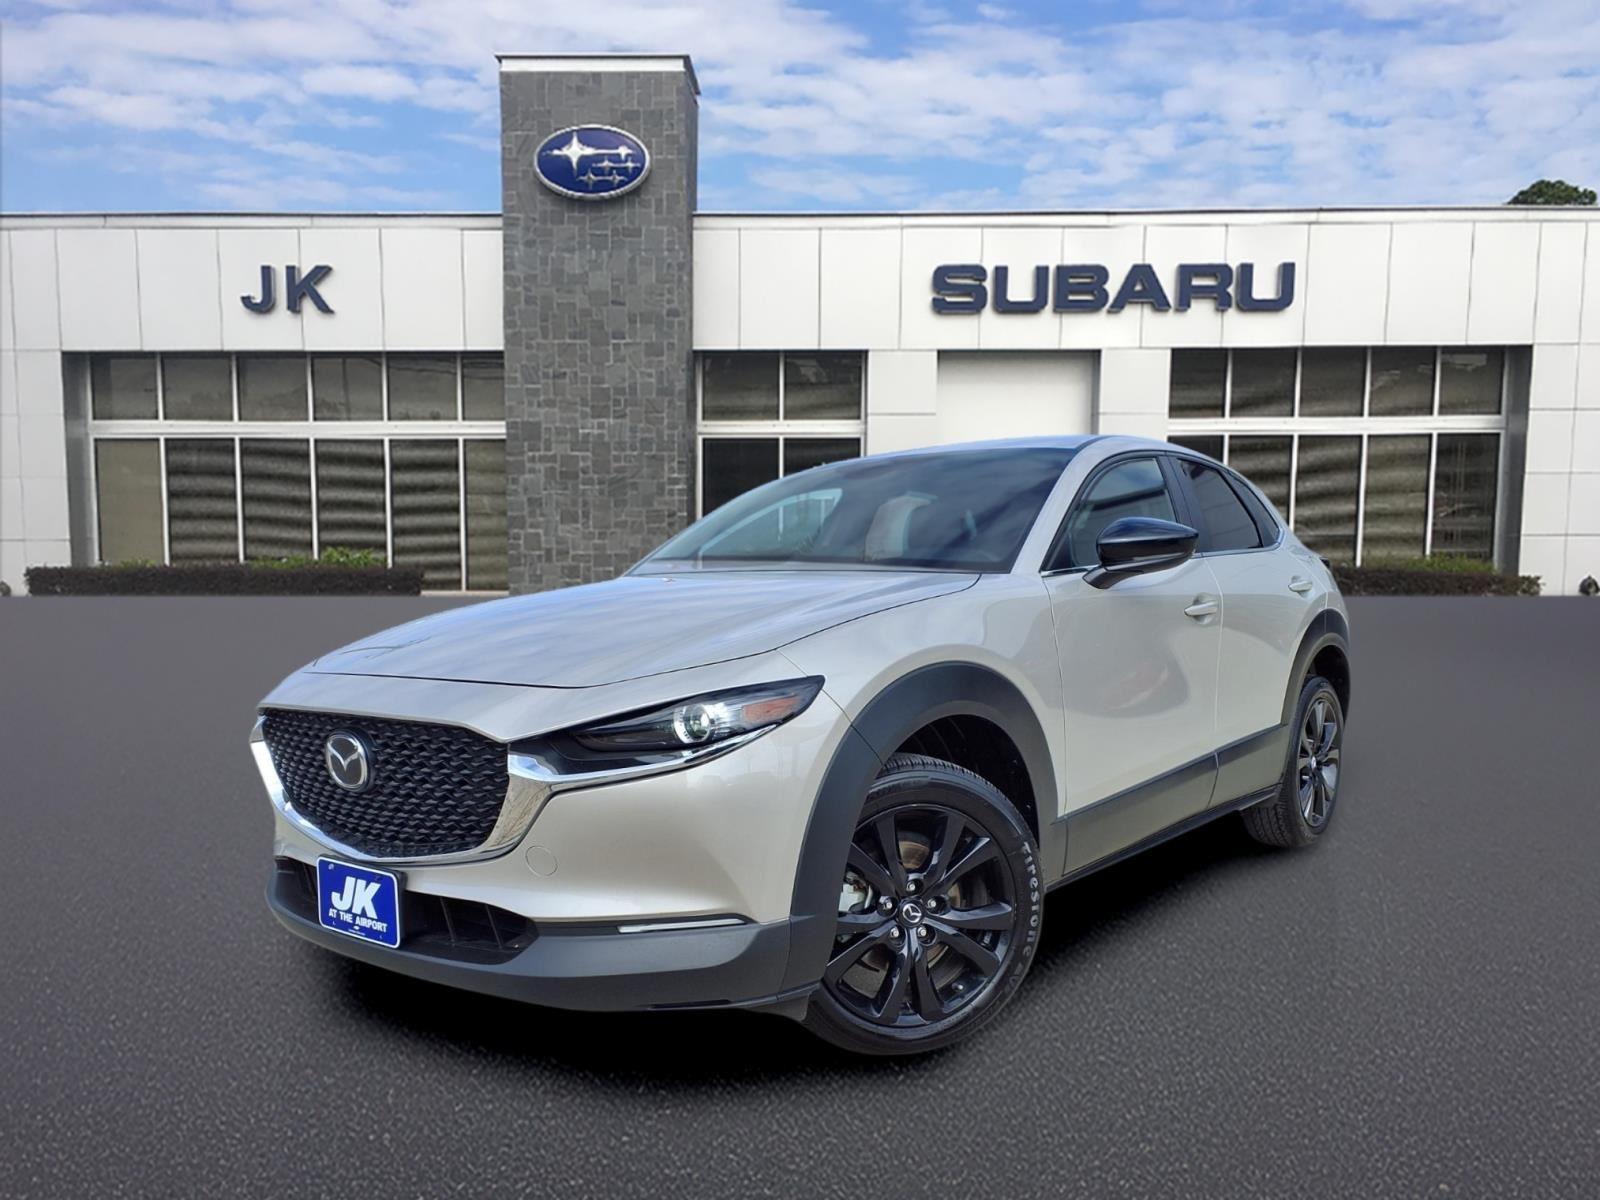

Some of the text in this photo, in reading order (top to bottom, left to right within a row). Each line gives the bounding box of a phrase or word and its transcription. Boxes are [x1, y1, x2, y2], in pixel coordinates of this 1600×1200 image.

[240, 265, 335, 315] JK
[931, 262, 1296, 315] SUBARU
[329, 908, 337, 918] AT
[339, 911, 353, 923] THE
[355, 916, 387, 933] AIRPORT
[331, 876, 382, 919] JK
